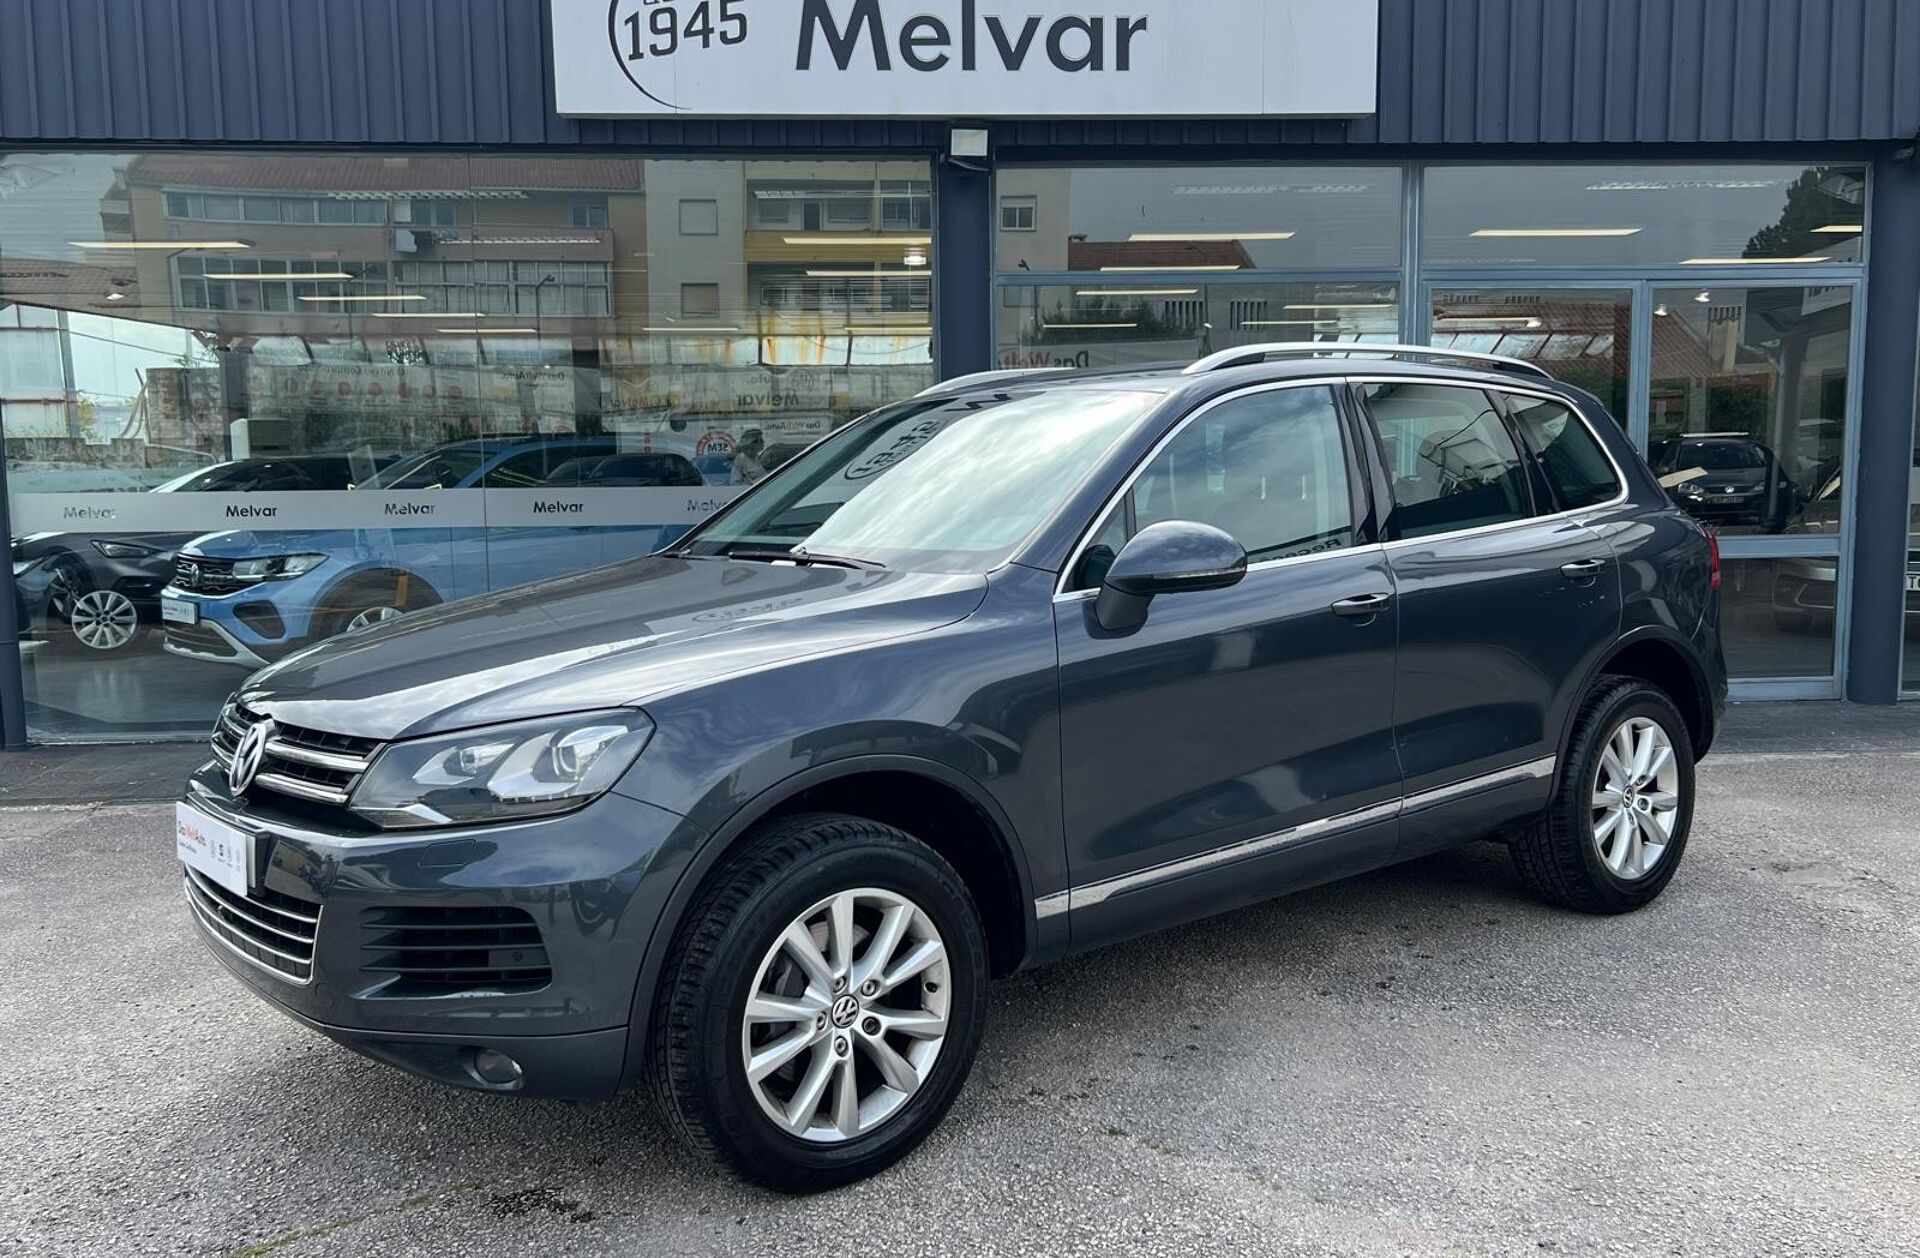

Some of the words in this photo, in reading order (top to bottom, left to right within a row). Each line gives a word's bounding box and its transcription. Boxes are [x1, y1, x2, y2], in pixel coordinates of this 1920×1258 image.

[624, 0, 748, 60] 1945
[795, 0, 1147, 72] Melvar
[226, 504, 278, 517] Melvar
[384, 502, 435, 516] Melvar
[533, 501, 584, 513] Melvar
[687, 499, 729, 511] Melv
